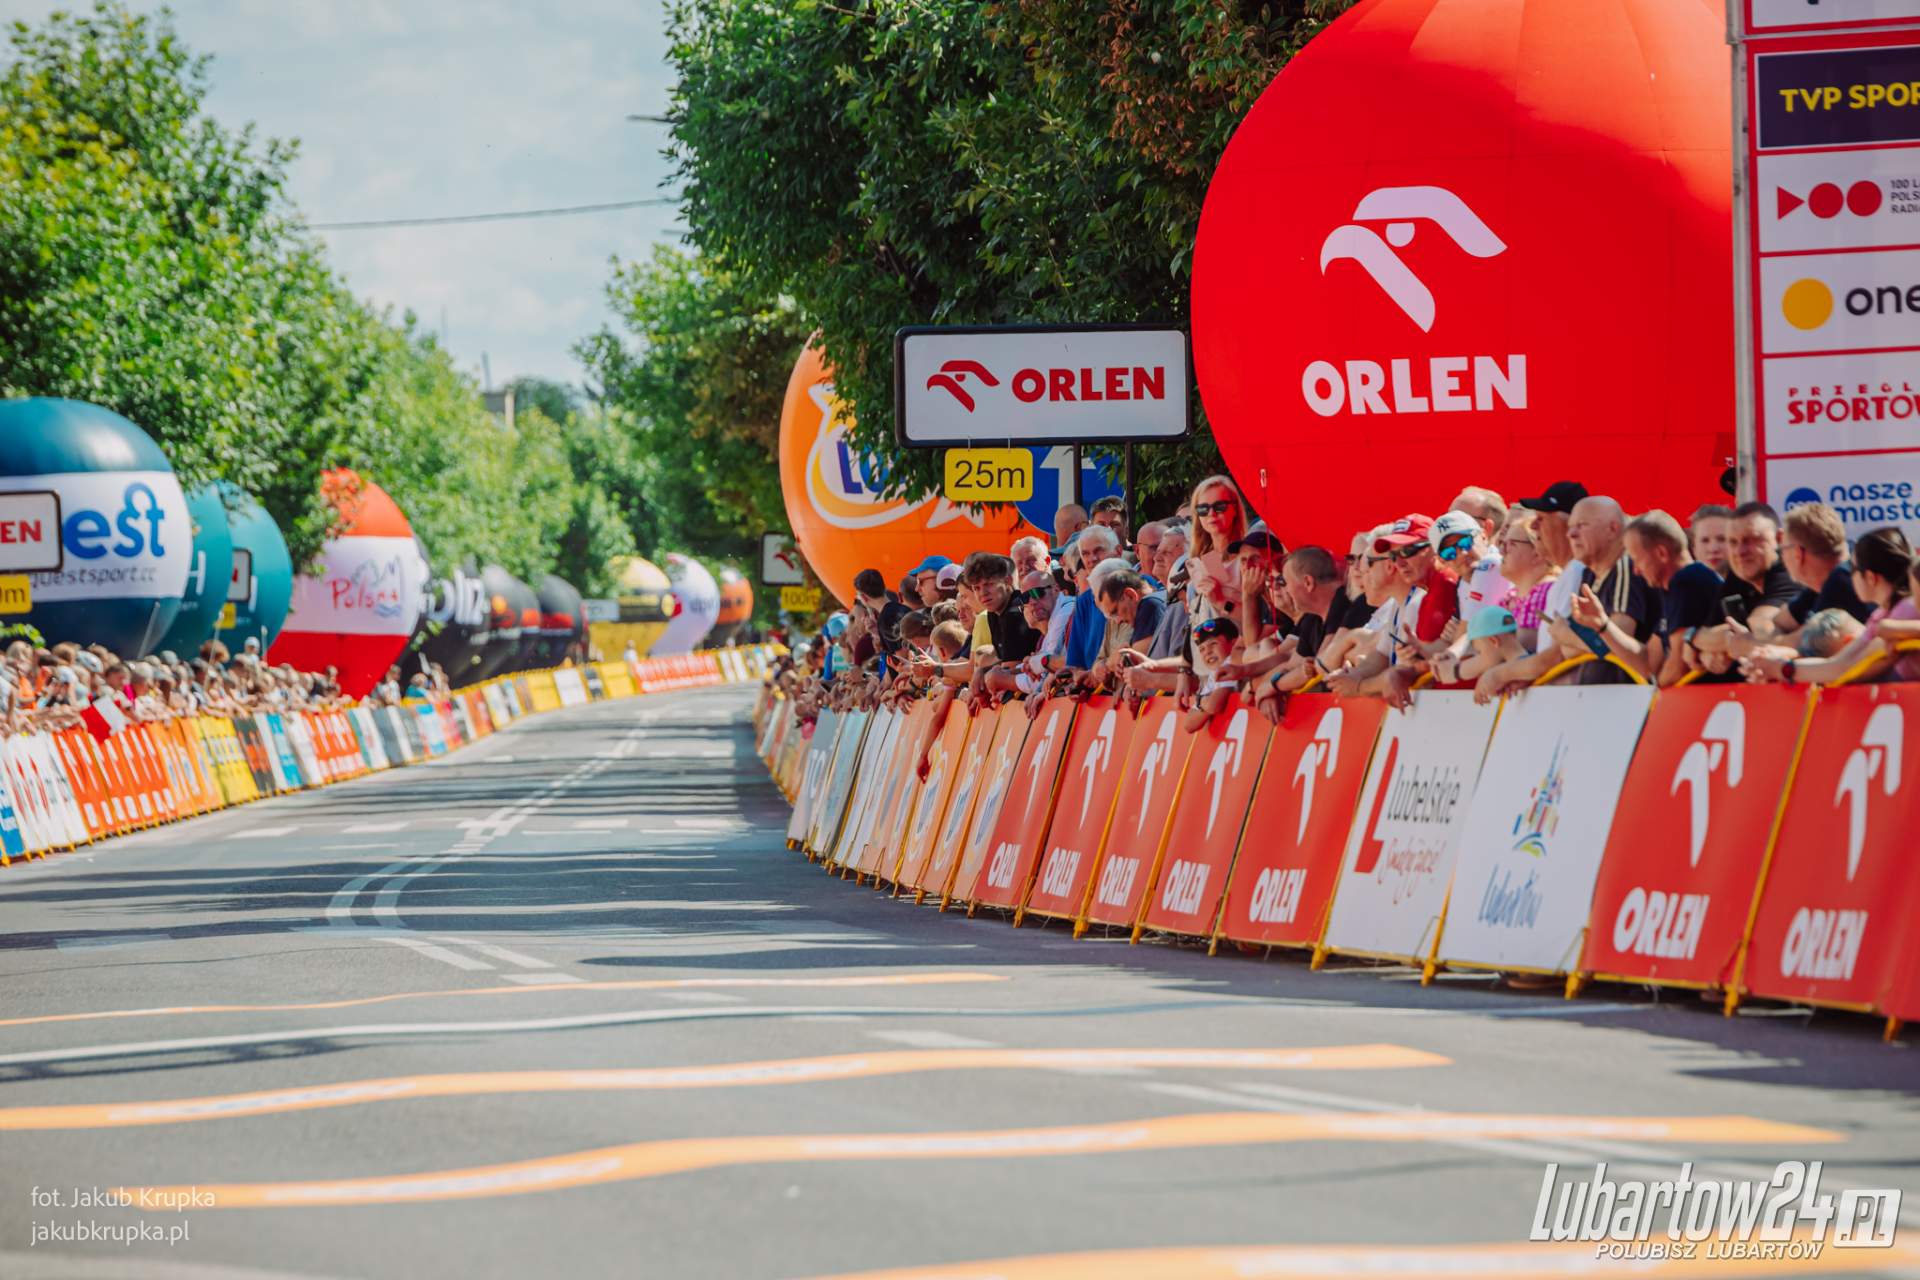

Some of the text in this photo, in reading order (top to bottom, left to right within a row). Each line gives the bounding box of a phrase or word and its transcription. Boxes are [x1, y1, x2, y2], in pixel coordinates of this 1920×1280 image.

[1779, 88, 1842, 112] TVP
[1012, 366, 1165, 403] ORLEN
[1302, 354, 1527, 416] ORLEN
[1787, 395, 1920, 425] SPORTO
[954, 460, 1025, 488] 25m
[1830, 482, 1912, 502] nasze
[0, 587, 26, 604] m
[1042, 847, 1081, 898] ORLEN
[1098, 854, 1140, 907] ORLEN
[1162, 859, 1211, 915] ORLEN
[1249, 867, 1307, 924] ORLEN
[1613, 887, 1710, 960] ORLEN
[1781, 907, 1869, 981] ORLEN
